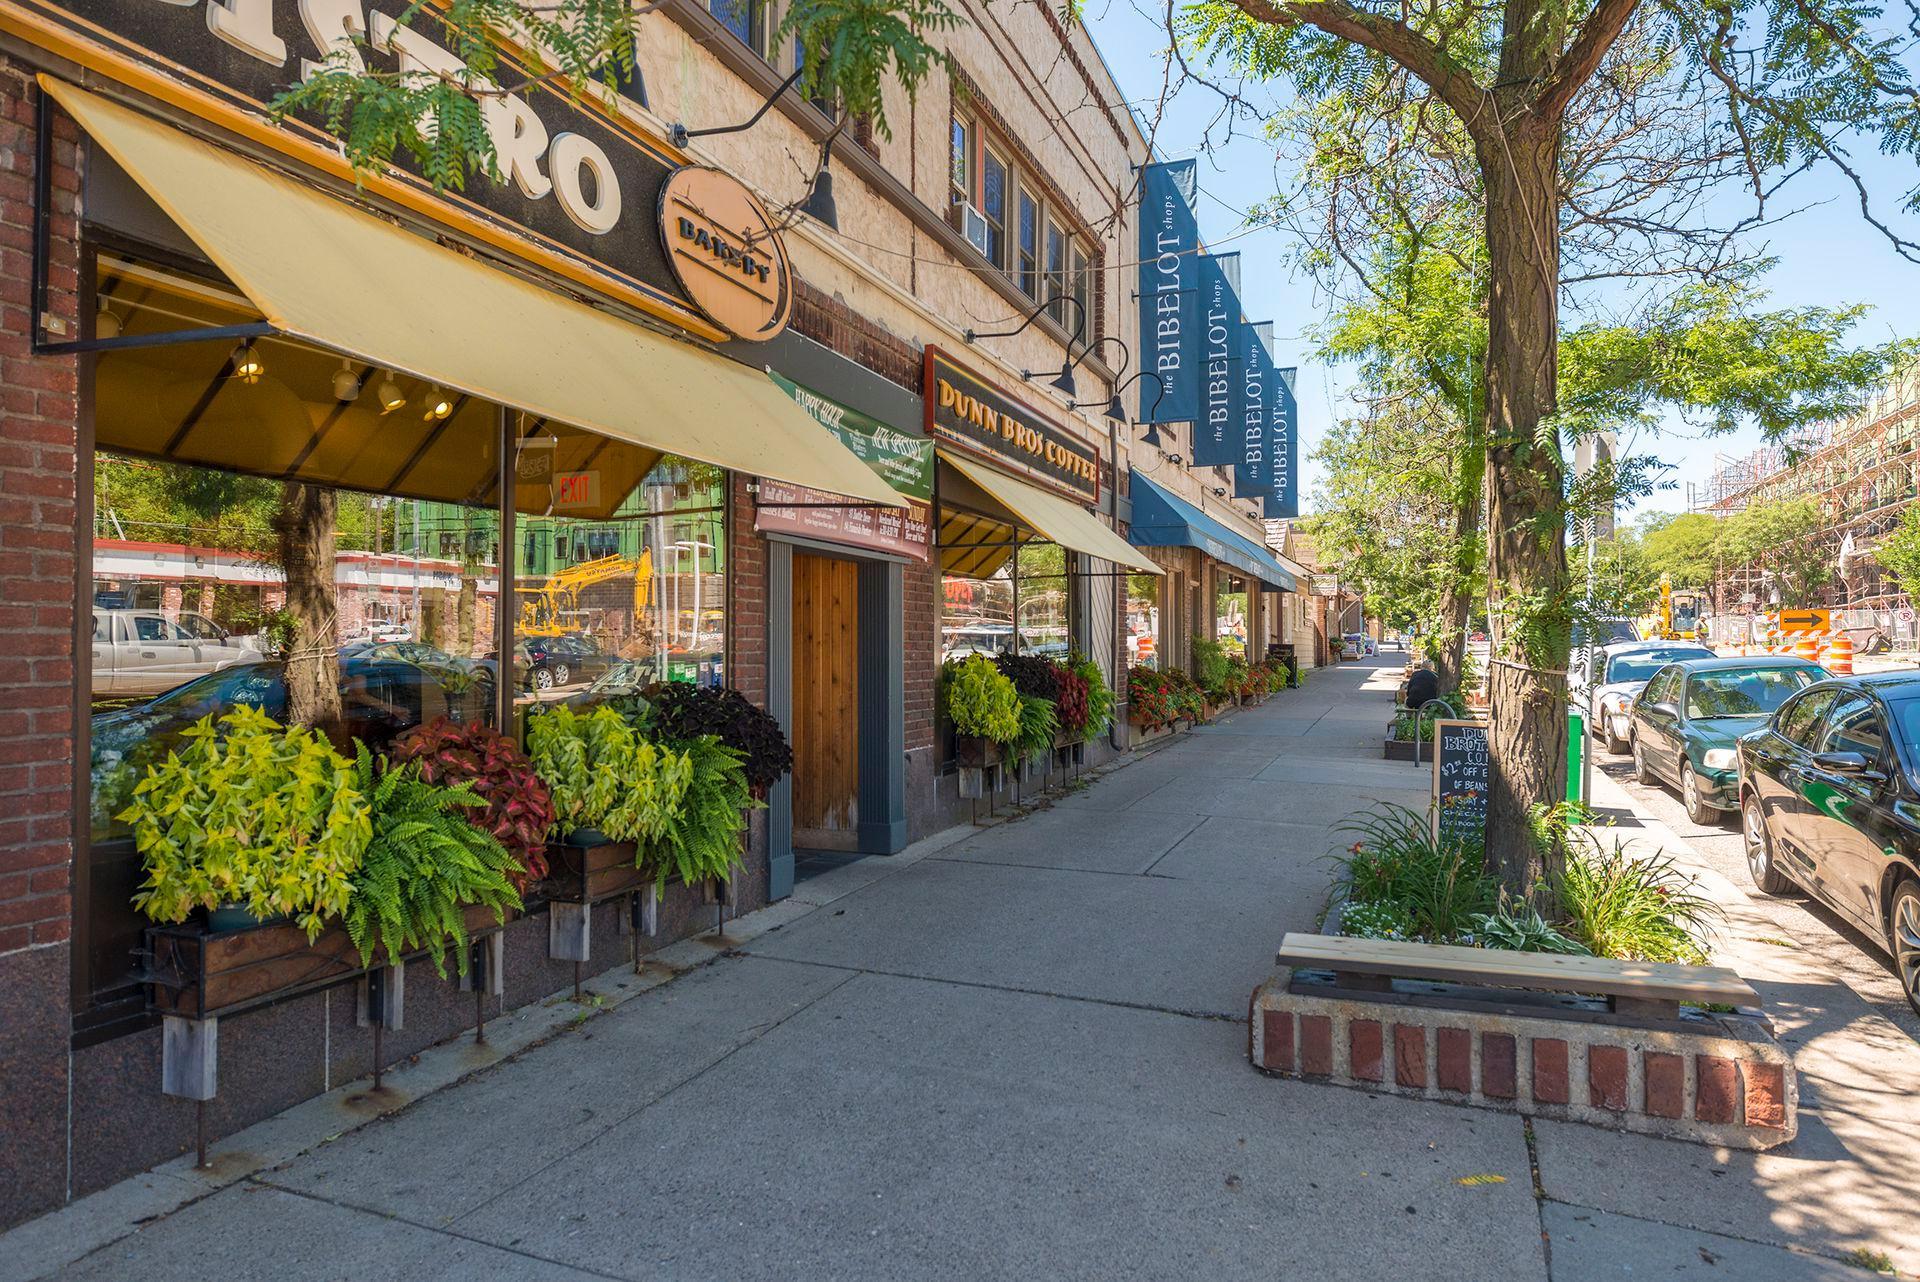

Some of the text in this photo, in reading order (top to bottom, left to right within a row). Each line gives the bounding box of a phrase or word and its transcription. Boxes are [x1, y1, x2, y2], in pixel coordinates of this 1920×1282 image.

[158, 0, 622, 235] ISTRO
[1157, 195, 1181, 394] the BIBELOT shops
[1208, 279, 1228, 442] the BIBELOT shops
[795, 388, 844, 429] HAPPY HOUR
[1245, 344, 1262, 478] the BIBELOT shops
[1277, 386, 1285, 407] shops
[872, 425, 893, 451] NEW
[938, 378, 998, 434] DUNN
[1045, 438, 1097, 482] COFFEE
[1273, 407, 1288, 489] BIBELOT
[560, 475, 589, 504] EXIT
[1444, 736, 1488, 752] BROT
[1467, 752, 1488, 763] CO
[1462, 766, 1478, 777] OFF
